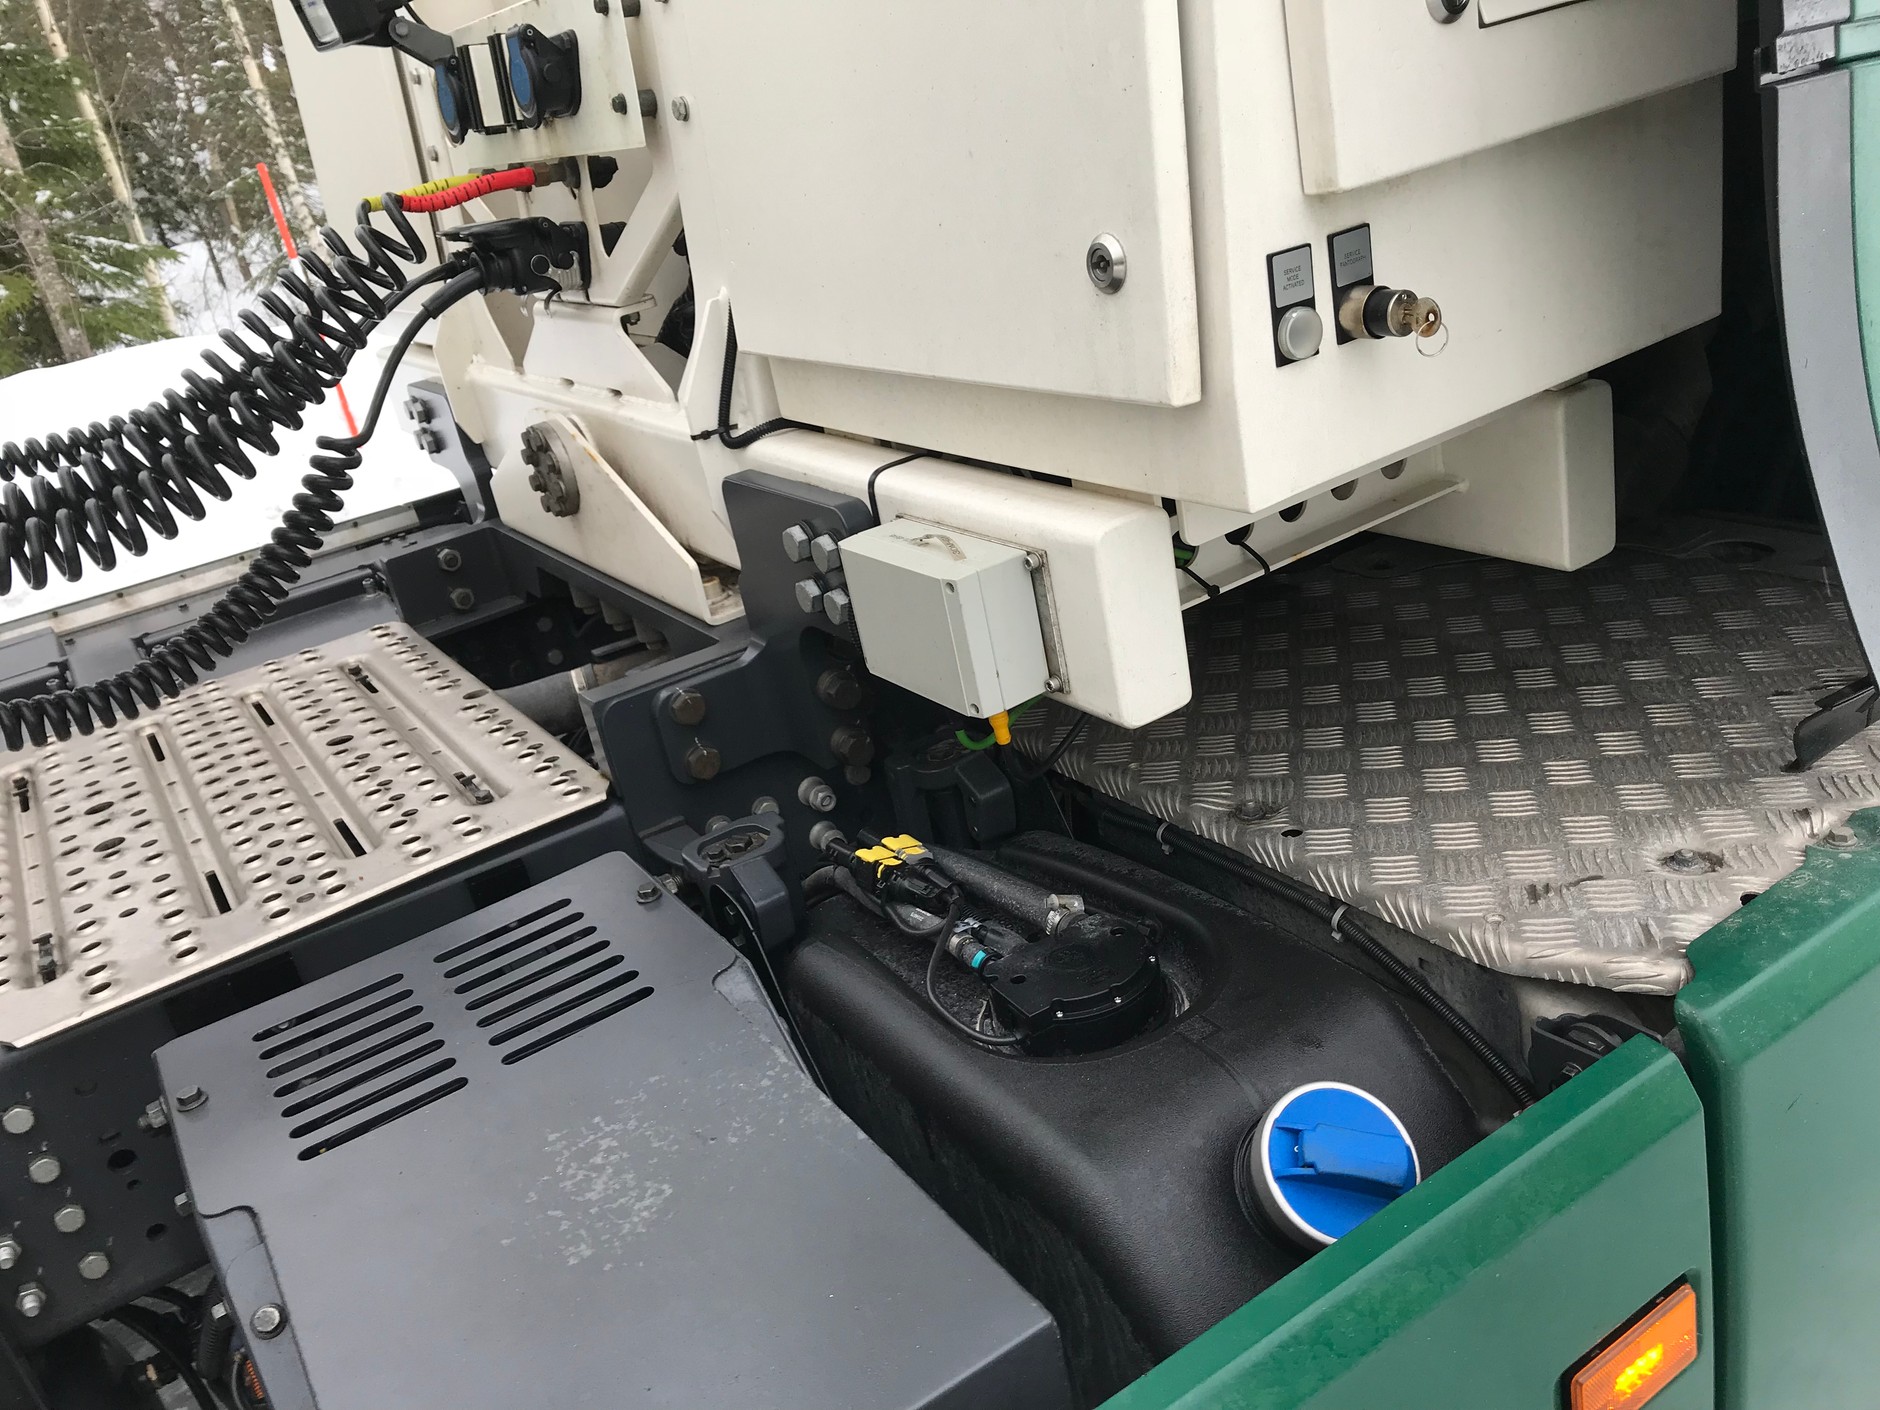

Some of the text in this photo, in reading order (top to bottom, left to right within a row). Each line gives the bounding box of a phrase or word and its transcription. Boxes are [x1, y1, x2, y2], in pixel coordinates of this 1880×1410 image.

[1344, 248, 1361, 259] SERVICE
[1283, 264, 1301, 276] SERVICE
[1286, 273, 1299, 282] MODE
[1282, 279, 1305, 291] ACTIVATED
